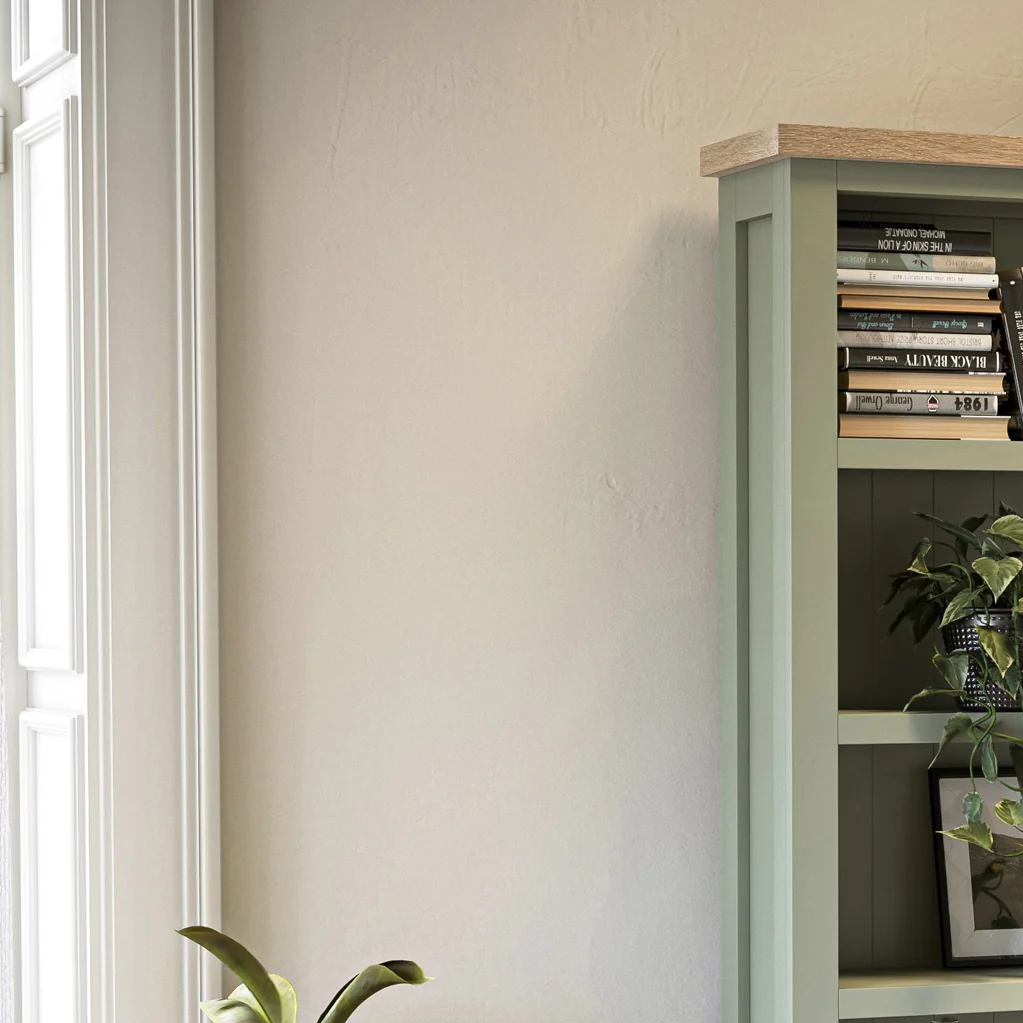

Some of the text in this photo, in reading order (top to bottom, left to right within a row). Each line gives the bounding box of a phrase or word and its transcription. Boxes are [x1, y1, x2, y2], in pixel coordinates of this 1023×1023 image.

[885, 228, 946, 239] MICHAEL ONDAATJE
[878, 240, 953, 252] IN THE SKIN OF A LION
[936, 337, 956, 346] SHORT
[866, 355, 884, 363] Sewell
[904, 354, 987, 369] BLACK BEAUTY
[855, 395, 883, 410] Orwell
[885, 393, 913, 412] George
[955, 396, 989, 411] 1984
